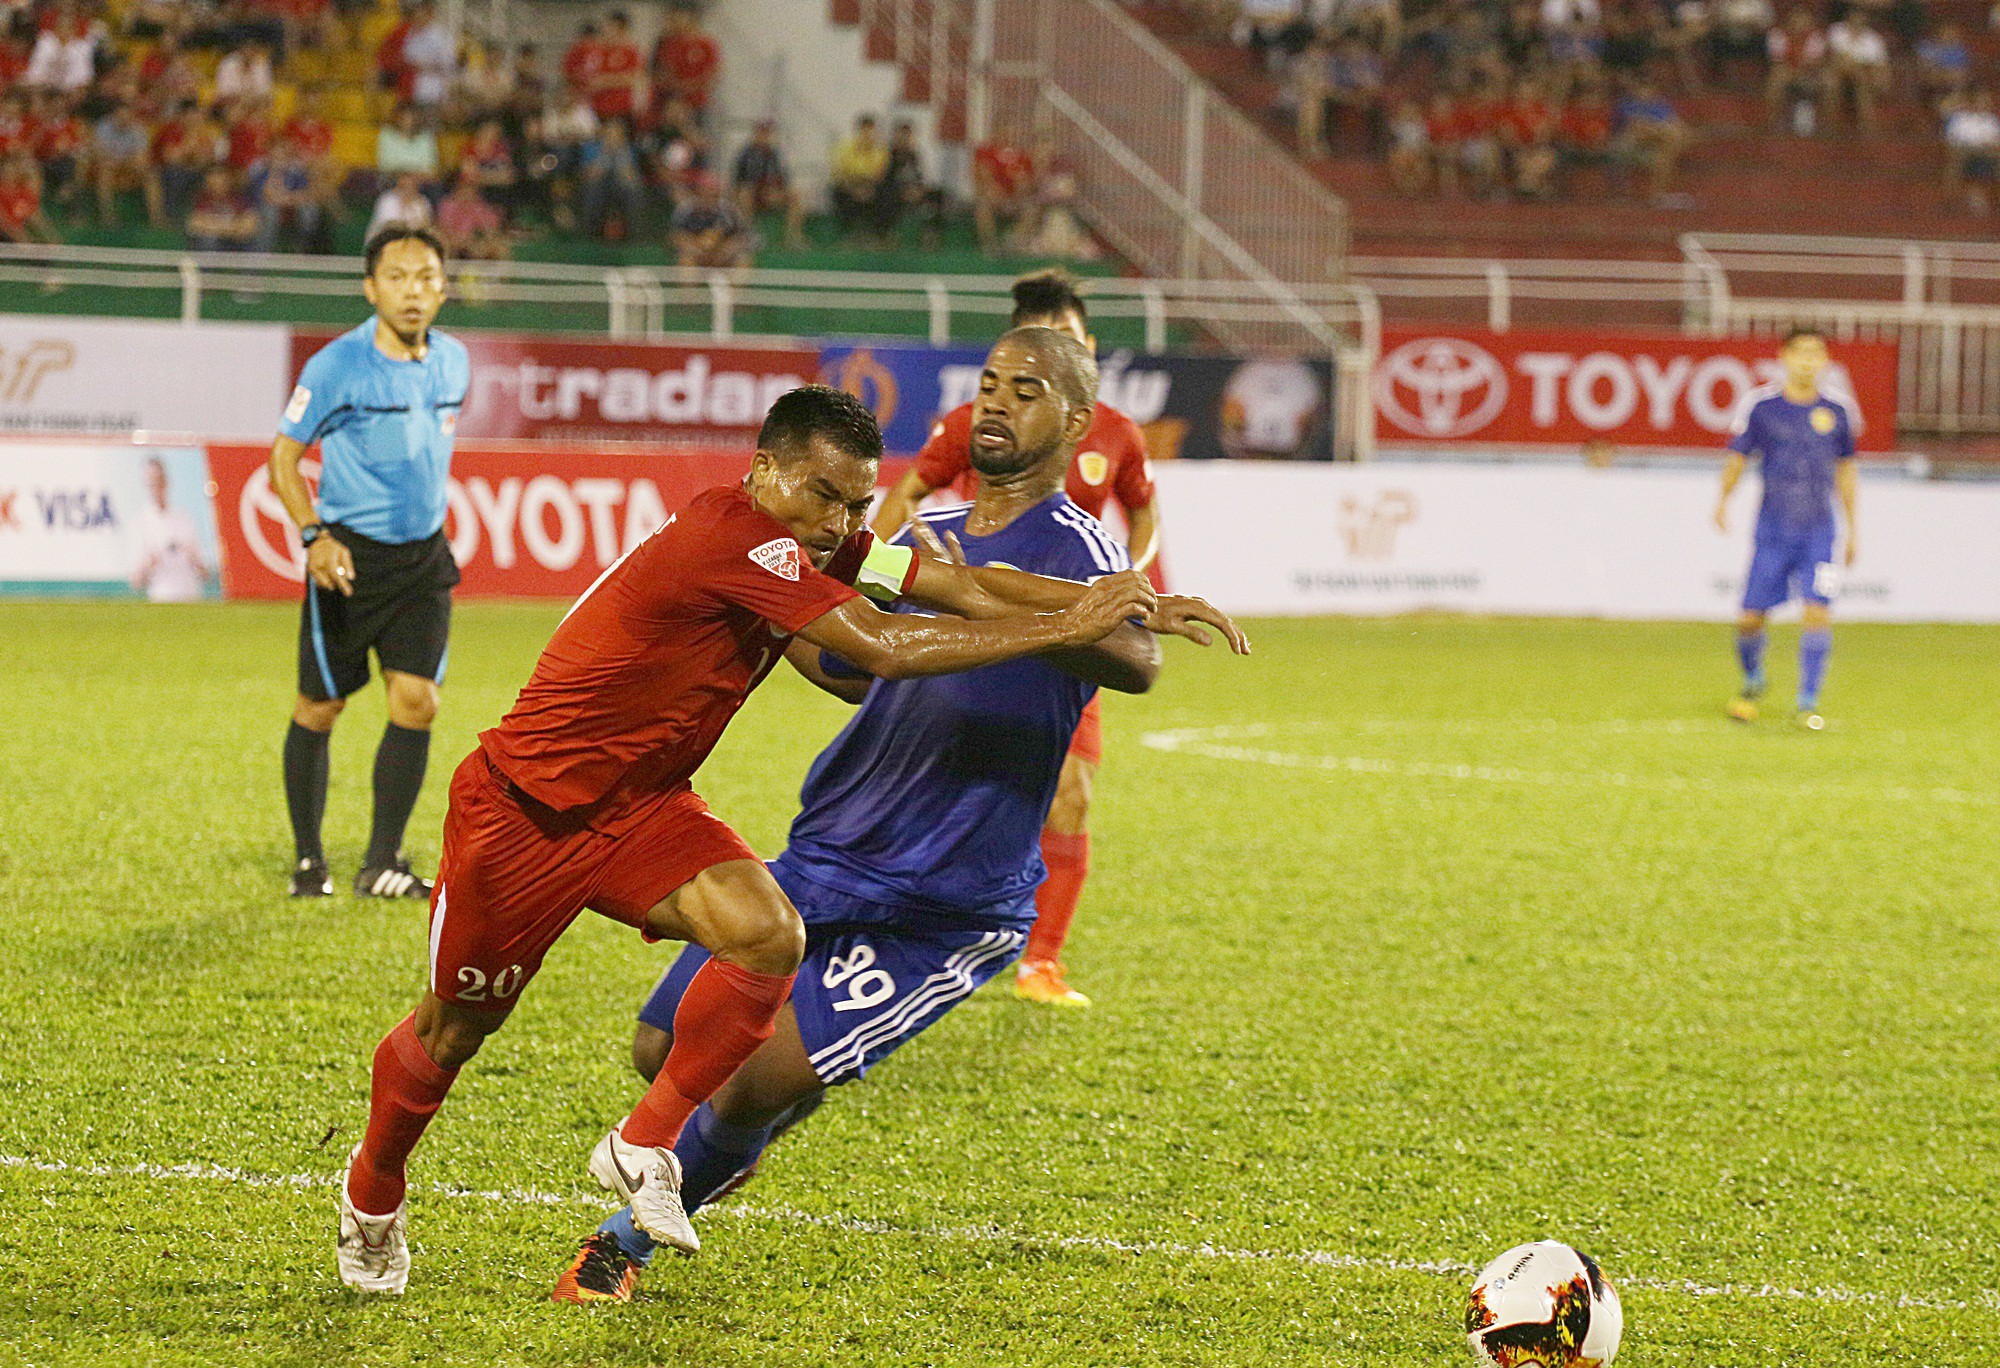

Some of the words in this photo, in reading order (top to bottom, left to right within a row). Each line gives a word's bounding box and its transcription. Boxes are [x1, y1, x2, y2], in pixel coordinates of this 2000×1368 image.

[34, 490, 119, 530] VISA
[446, 475, 671, 570] OYOTA
[752, 541, 796, 560] TOYOTA
[456, 964, 523, 1001] 20
[822, 944, 897, 1012] 89
